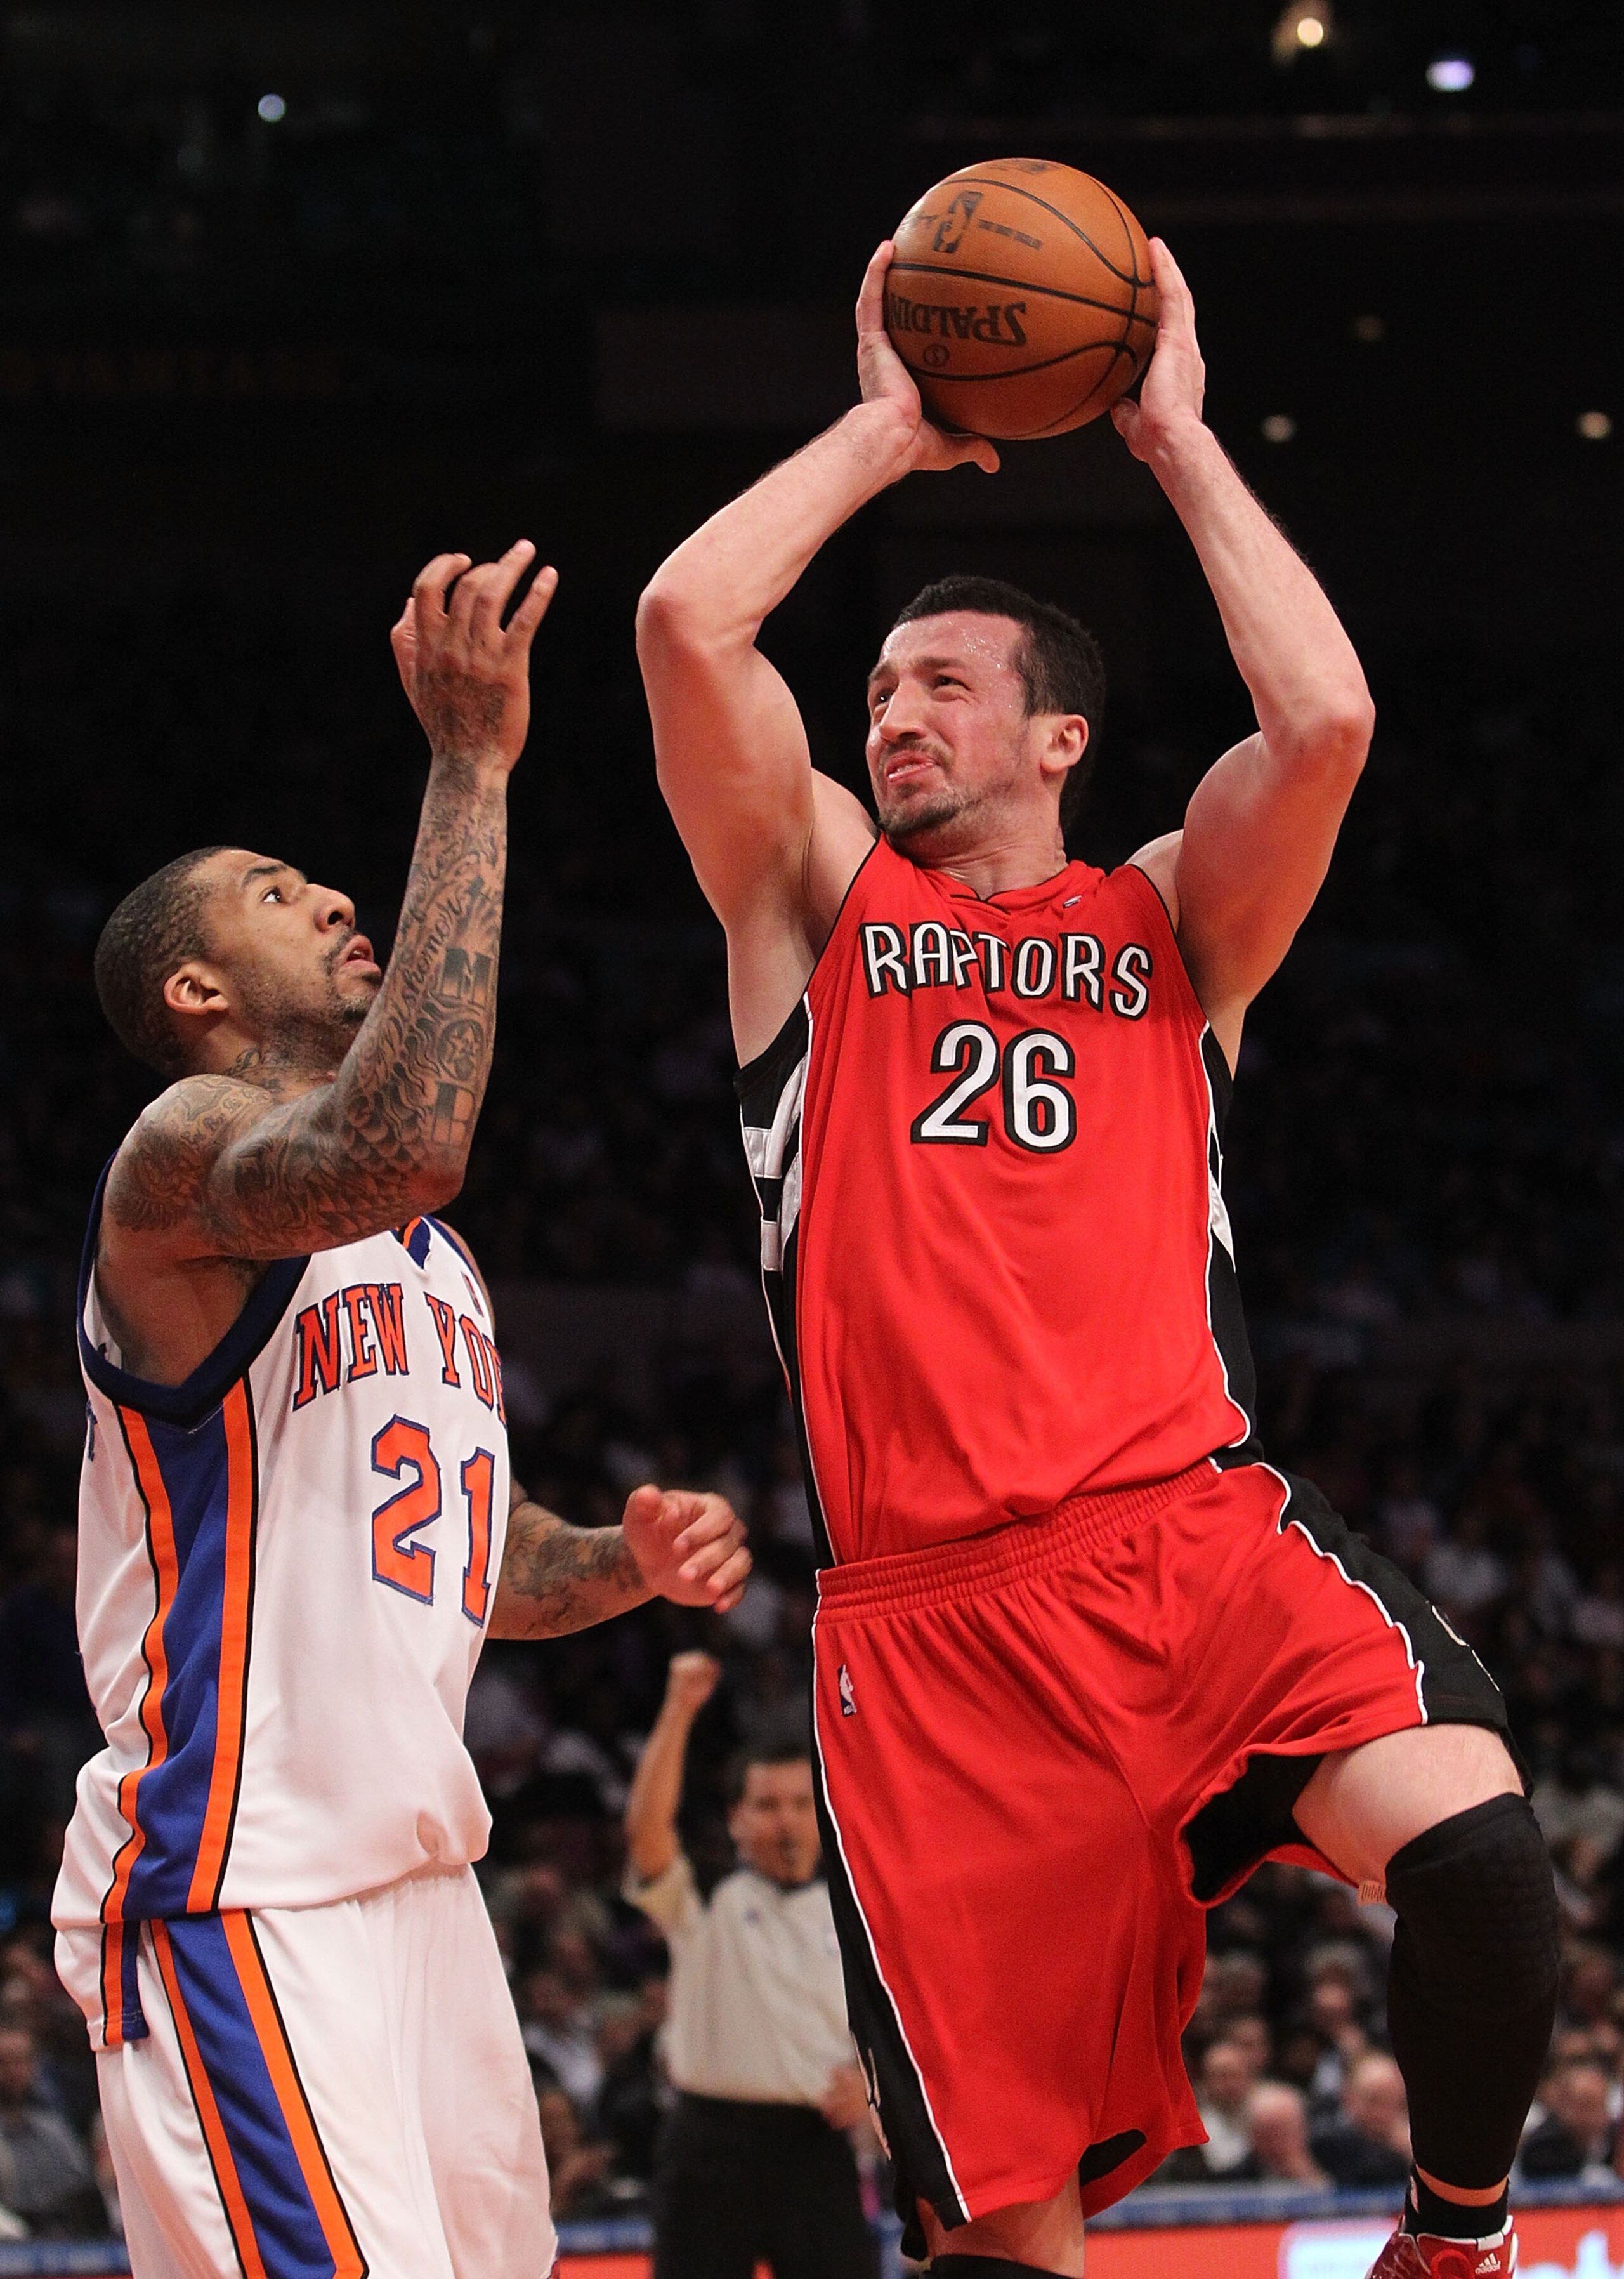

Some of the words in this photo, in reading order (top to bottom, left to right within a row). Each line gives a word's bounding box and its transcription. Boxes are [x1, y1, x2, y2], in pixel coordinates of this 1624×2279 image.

[890, 295, 1026, 346] SPALDIN
[860, 921, 1153, 1020] RAPTORS
[910, 1019, 1078, 1154] 26
[292, 1283, 409, 1412] NEW
[371, 1414, 496, 1628] 21
